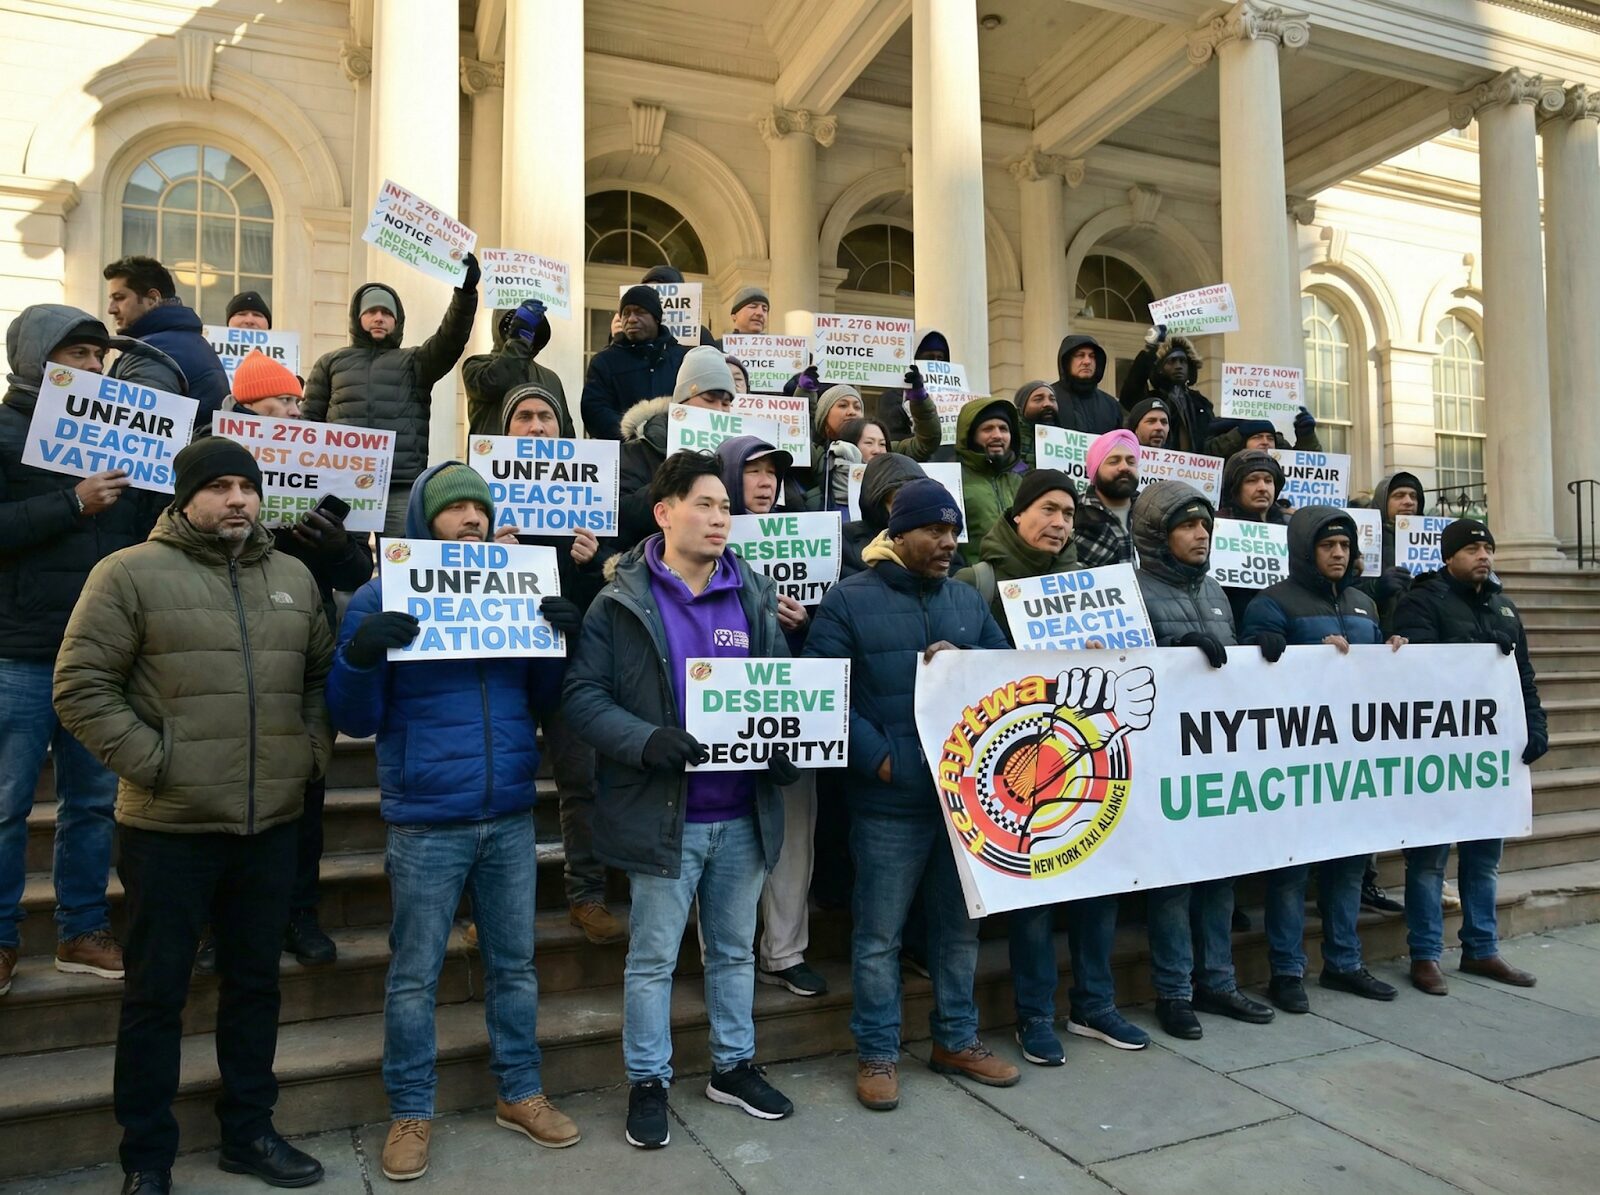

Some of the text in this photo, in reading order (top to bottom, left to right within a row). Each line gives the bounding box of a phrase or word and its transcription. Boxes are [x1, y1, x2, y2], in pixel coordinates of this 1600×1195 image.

[385, 183, 412, 206] INT.
[415, 201, 440, 221] 276
[384, 213, 433, 246] NOTICE
[388, 203, 466, 250] JUST CAUSE
[375, 236, 420, 266] APPEAL
[483, 251, 509, 261] INT.
[513, 253, 536, 265] 276
[494, 264, 527, 273] JUST
[495, 276, 542, 288] NOTICE
[654, 285, 678, 296] ND
[817, 317, 910, 333] INT. 276 NOW!
[228, 329, 268, 344] END
[725, 337, 748, 346] INT.
[751, 337, 772, 346] 276
[826, 332, 905, 346] JUST CAUSE
[734, 348, 802, 359] JUST CAUSE
[826, 345, 874, 357] NOTICE
[741, 360, 775, 368] OTICE
[927, 362, 950, 374] END
[1225, 366, 1247, 375] INT.
[1250, 367, 1270, 376] 276
[749, 380, 774, 388] PEAL
[824, 370, 870, 381] APPEAL
[1263, 380, 1296, 390] CAUSE
[98, 378, 157, 410] END
[1232, 388, 1272, 398] NOTICE
[738, 397, 805, 411] 276 NOW!
[1232, 408, 1269, 418] APPEAL
[65, 394, 174, 438] UNFAIR
[709, 412, 742, 433] WE
[54, 417, 171, 460] DEACTI-
[219, 417, 389, 450] INT. 276 NOW!
[1065, 431, 1088, 448] WE
[516, 438, 575, 460] END
[1044, 442, 1087, 462] DESE
[1141, 450, 1159, 461] NT.
[1163, 453, 1185, 465] 276
[1295, 452, 1327, 466] END
[298, 451, 377, 472] CAUSE
[492, 460, 599, 483] UNFAIR
[262, 471, 319, 489] TICE
[1142, 464, 1173, 476] JUST
[1177, 468, 1215, 481] CAUSE
[1281, 465, 1339, 481] UNFAIR
[488, 482, 603, 505] DEACTI-
[494, 507, 613, 531] ATIONS!
[758, 516, 799, 537] WE
[1239, 523, 1269, 539] WE
[1409, 532, 1442, 545] UNF
[441, 542, 508, 569] END
[1215, 536, 1288, 557] DESERV
[1241, 555, 1280, 571] JOB
[409, 568, 542, 594] UNFAIR
[1039, 571, 1095, 595] END
[1023, 587, 1126, 618] UNFAIR
[1026, 608, 1134, 640] DEACTI-
[744, 662, 792, 685] WE
[702, 689, 835, 713] DESERVE
[737, 716, 801, 739] JOB
[938, 674, 1047, 794] nytwa
[1179, 698, 1498, 756] NYTWA UNFAIR
[698, 740, 844, 764] SECURITY!
[1159, 750, 1511, 821] UEACTIVATIONS!
[1033, 783, 1127, 875] NEW YORK TAXI ALLIANCE
